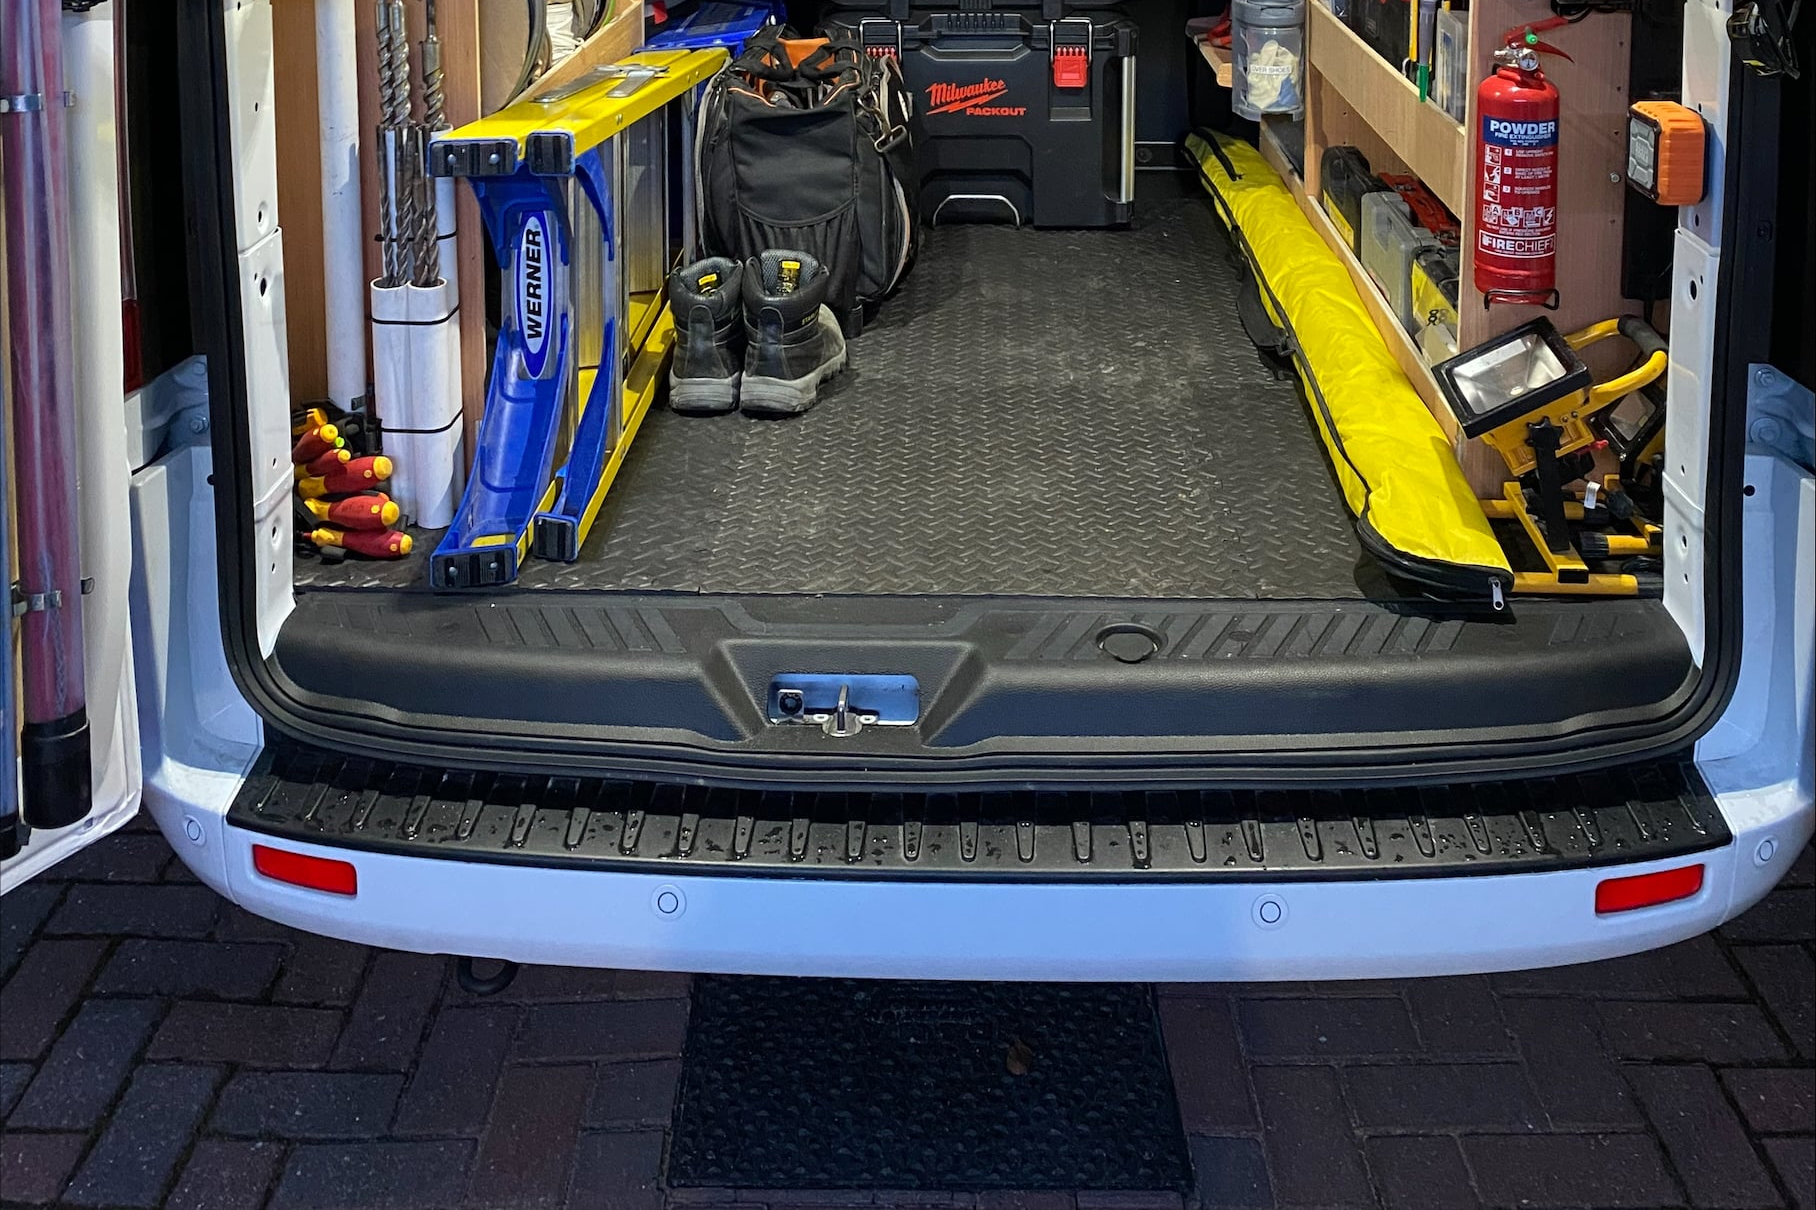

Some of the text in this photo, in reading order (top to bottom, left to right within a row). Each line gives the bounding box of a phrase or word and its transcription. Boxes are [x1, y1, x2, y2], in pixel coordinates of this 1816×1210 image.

[1251, 64, 1291, 74] OVER SHOES
[925, 77, 1007, 107] Milwaukee
[965, 107, 1027, 116] PACKOUT
[1489, 119, 1556, 135] POWDER
[1509, 132, 1552, 140] EXTINGUISHER
[1492, 206, 1542, 216] A B C
[1482, 234, 1551, 252] FIRECHIEF
[526, 228, 543, 340] WERNER
